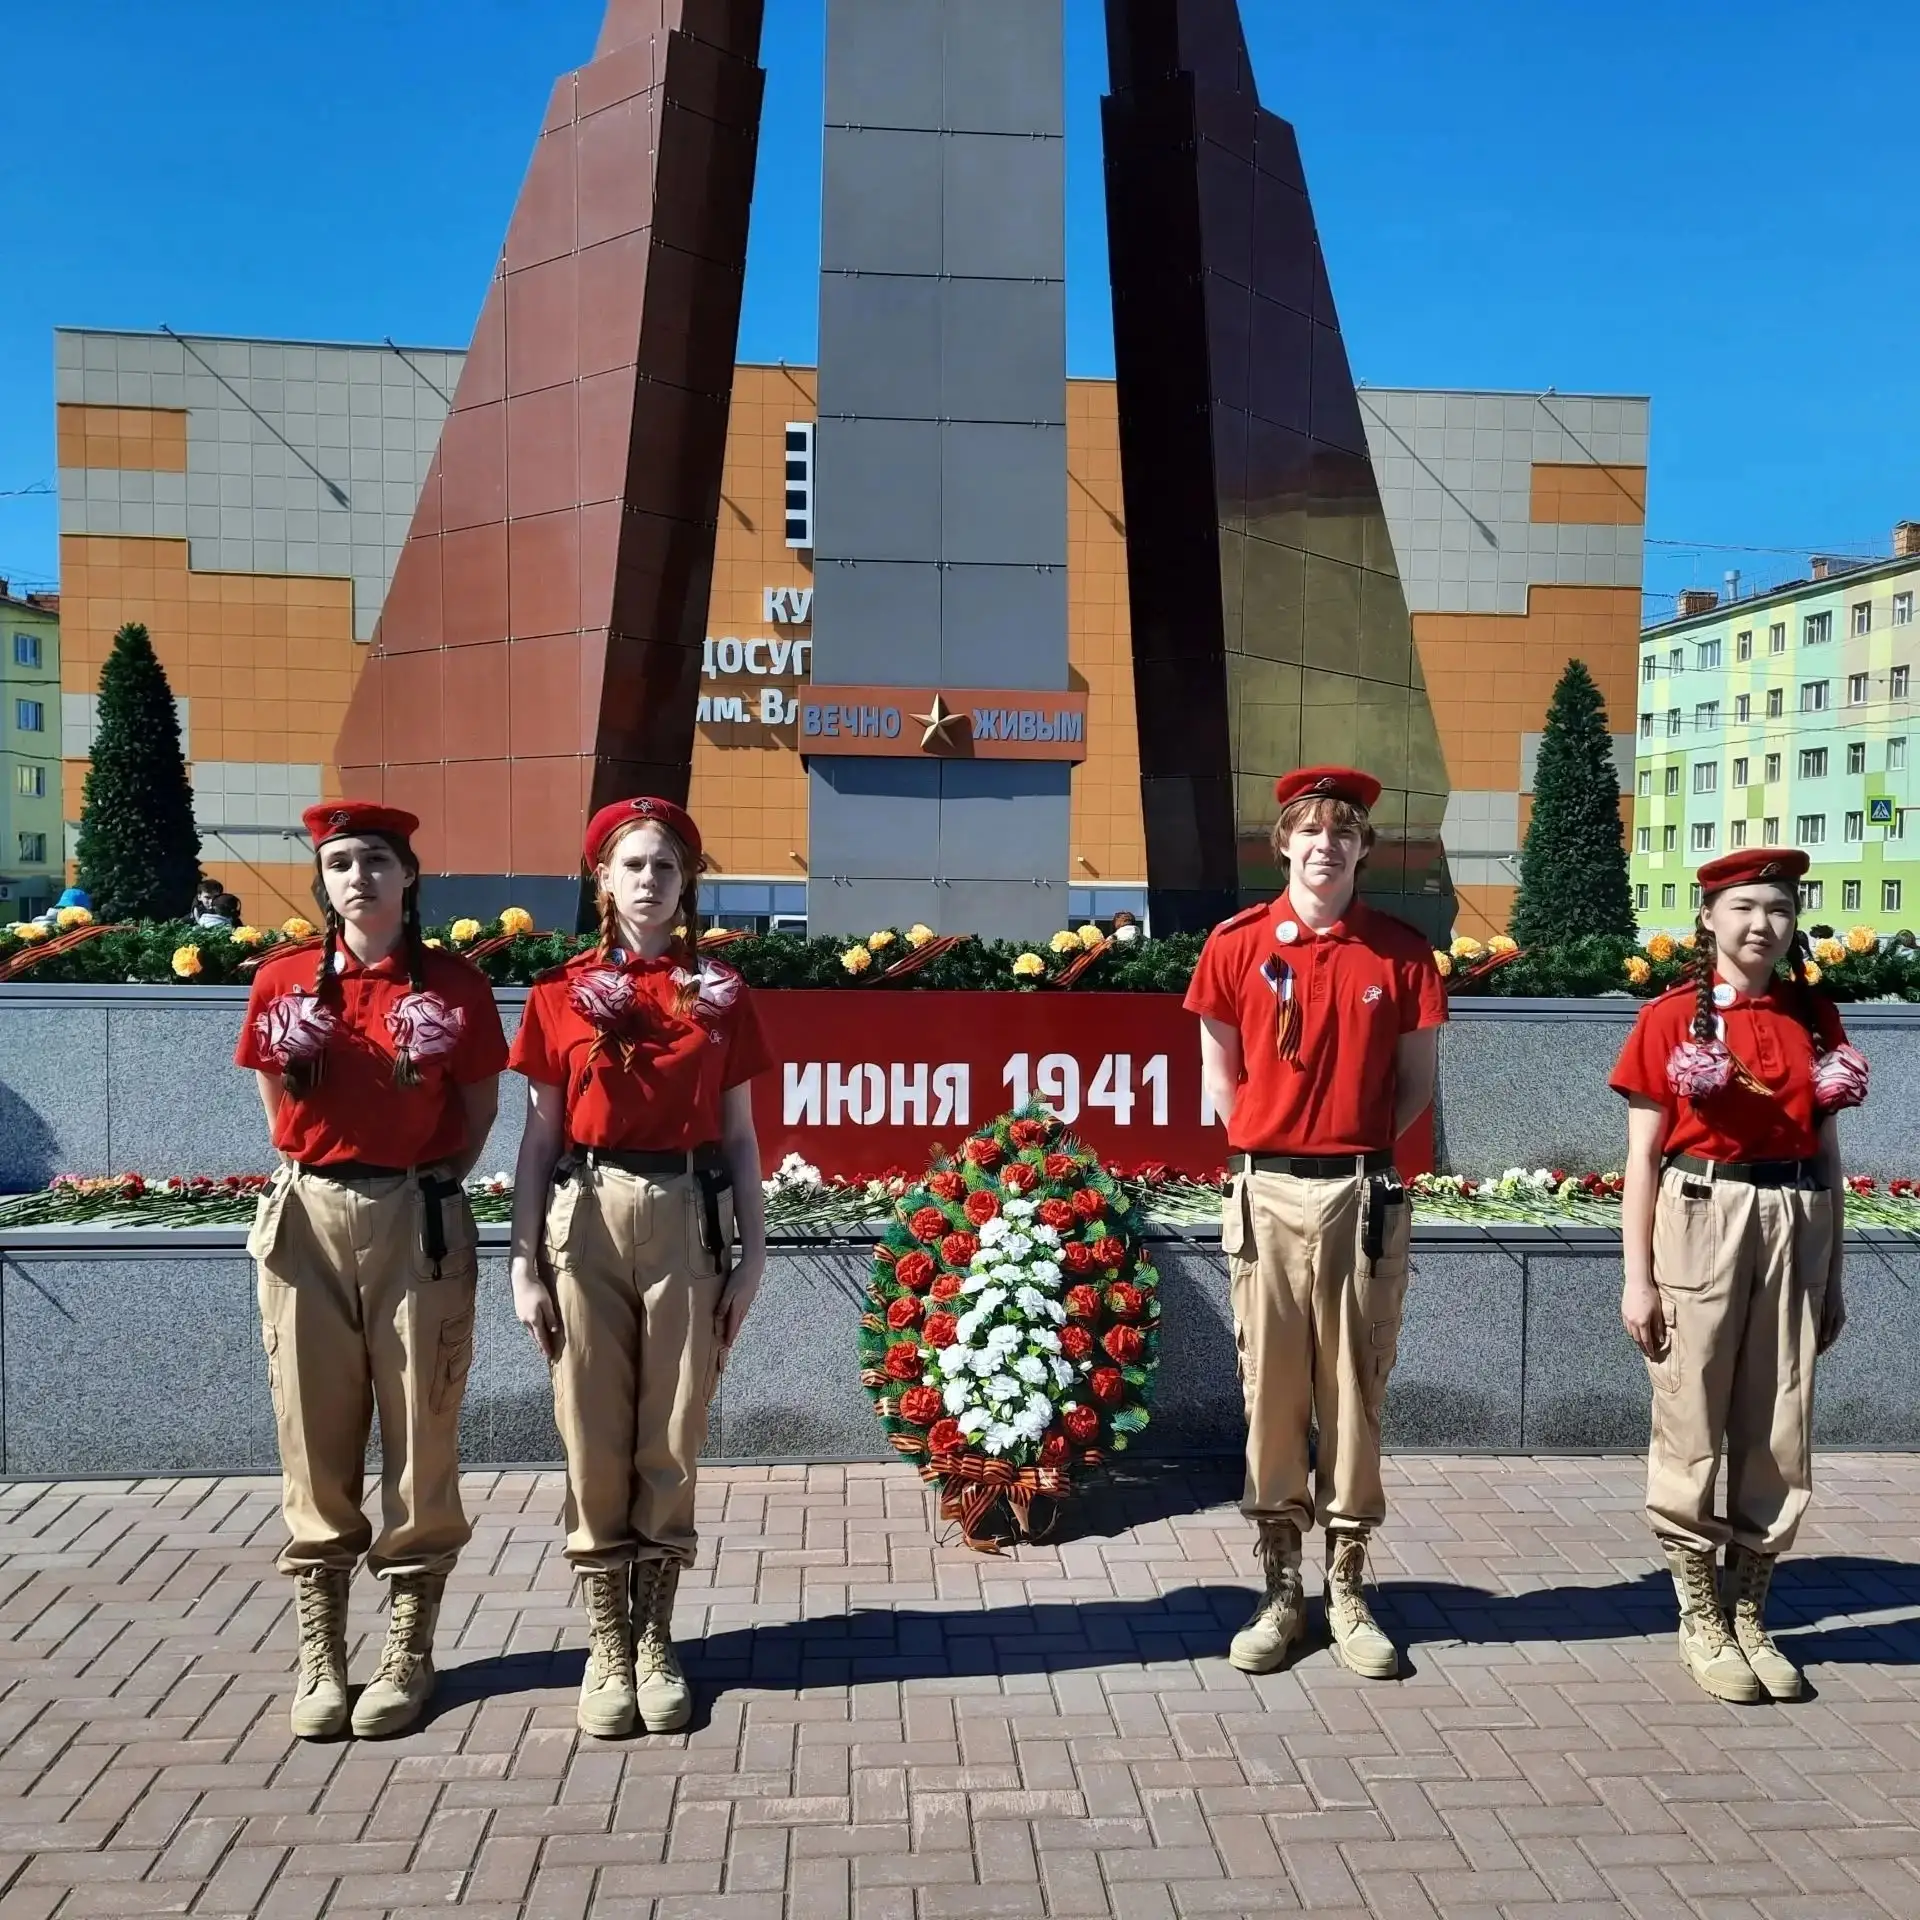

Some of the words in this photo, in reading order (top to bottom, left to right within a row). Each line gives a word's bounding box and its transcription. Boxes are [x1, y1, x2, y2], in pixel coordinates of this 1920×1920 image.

[803, 704, 900, 738] ВЕЧНО
[972, 708, 1084, 742] ЖИВЫМ
[783, 1062, 970, 1126] ИЮНЯ
[1002, 1052, 1169, 1126] 1941
